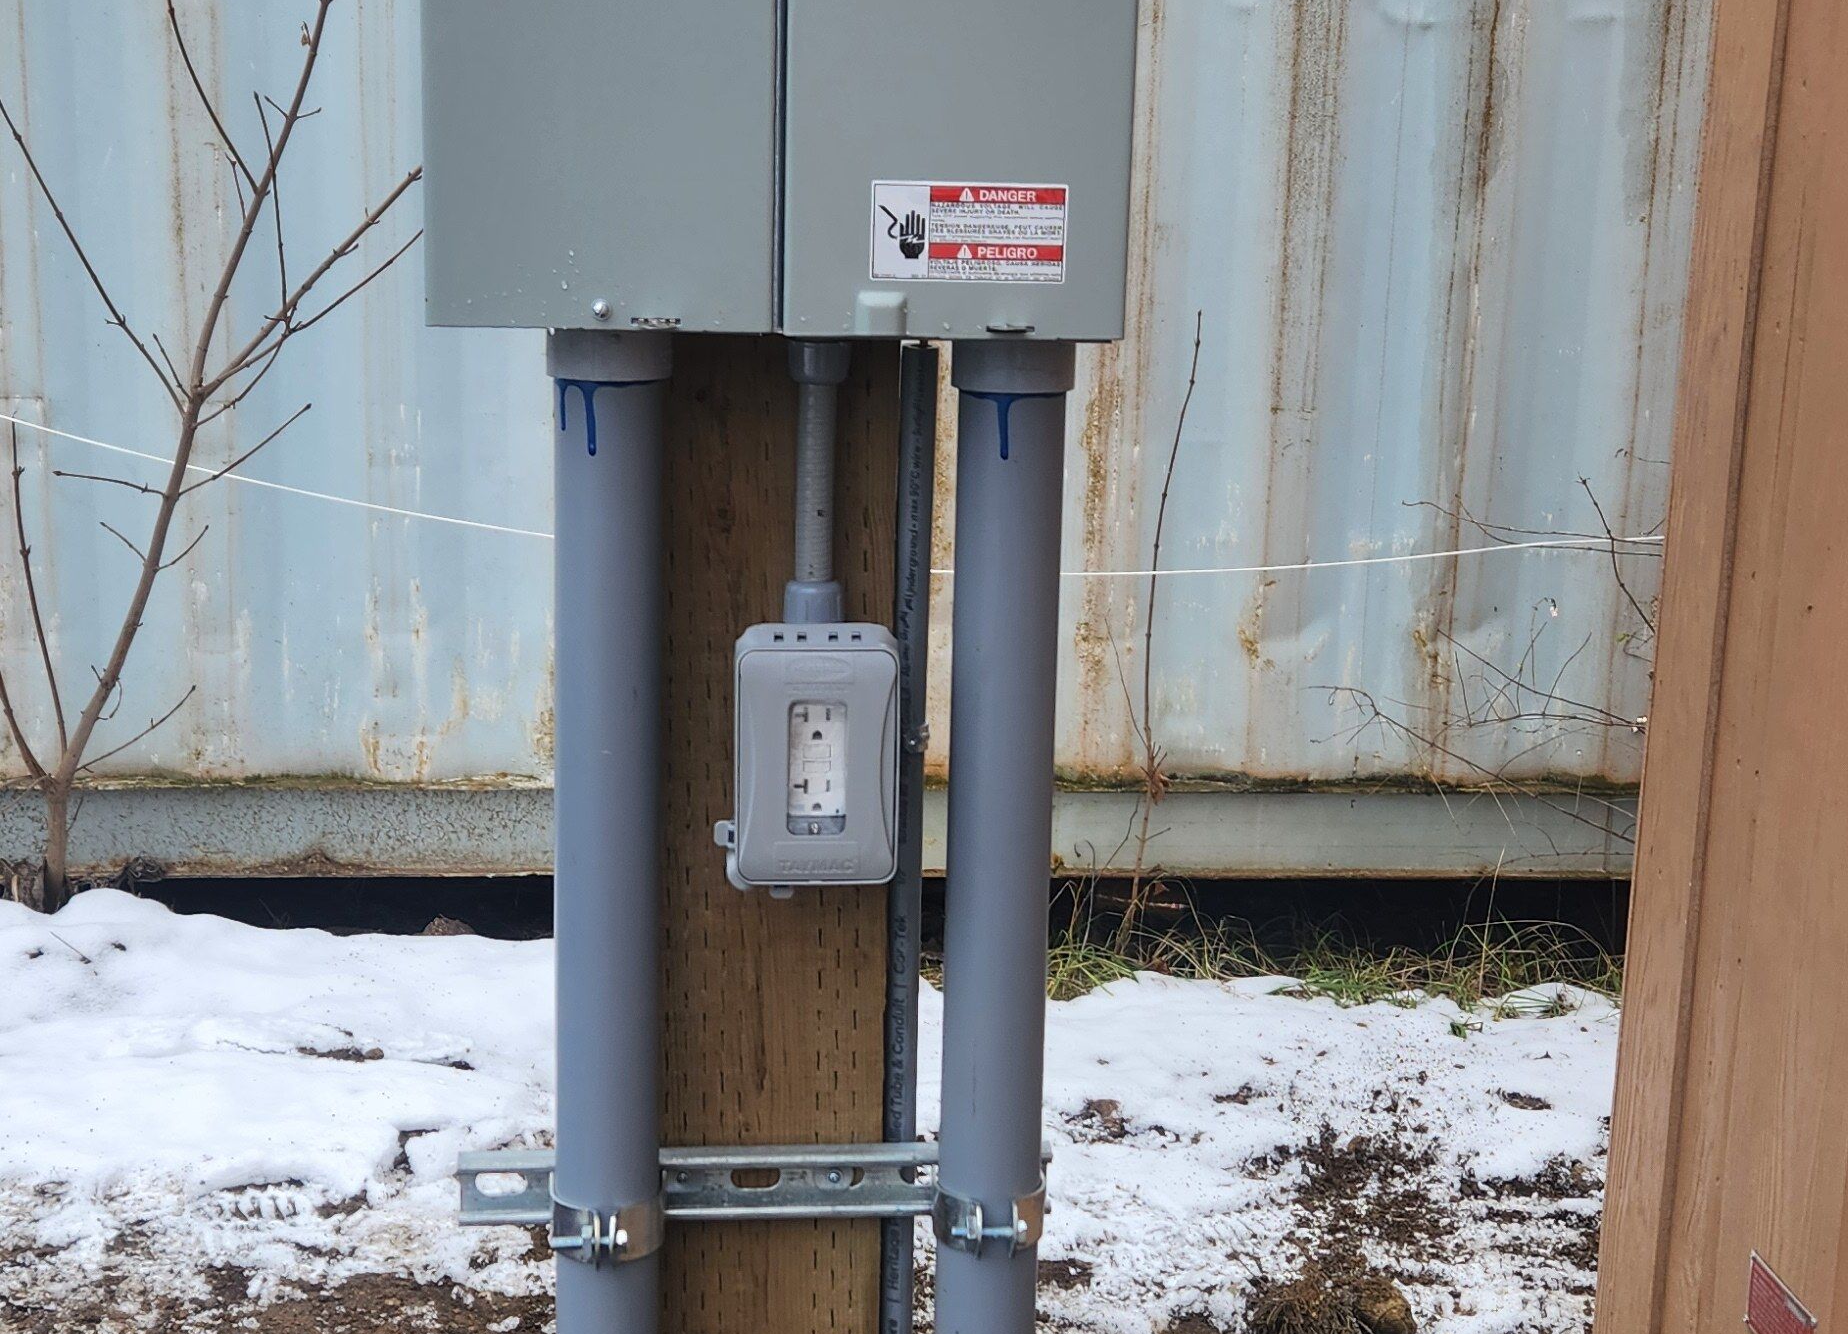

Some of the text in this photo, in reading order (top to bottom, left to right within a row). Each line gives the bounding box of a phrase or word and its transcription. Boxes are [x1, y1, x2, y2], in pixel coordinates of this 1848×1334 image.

[979, 189, 1037, 202] DANGER
[977, 246, 1038, 259] PELIGRO
[891, 996, 905, 1055] Conduit
[889, 1072, 903, 1107] Tube
[886, 1228, 901, 1290] Heritage
